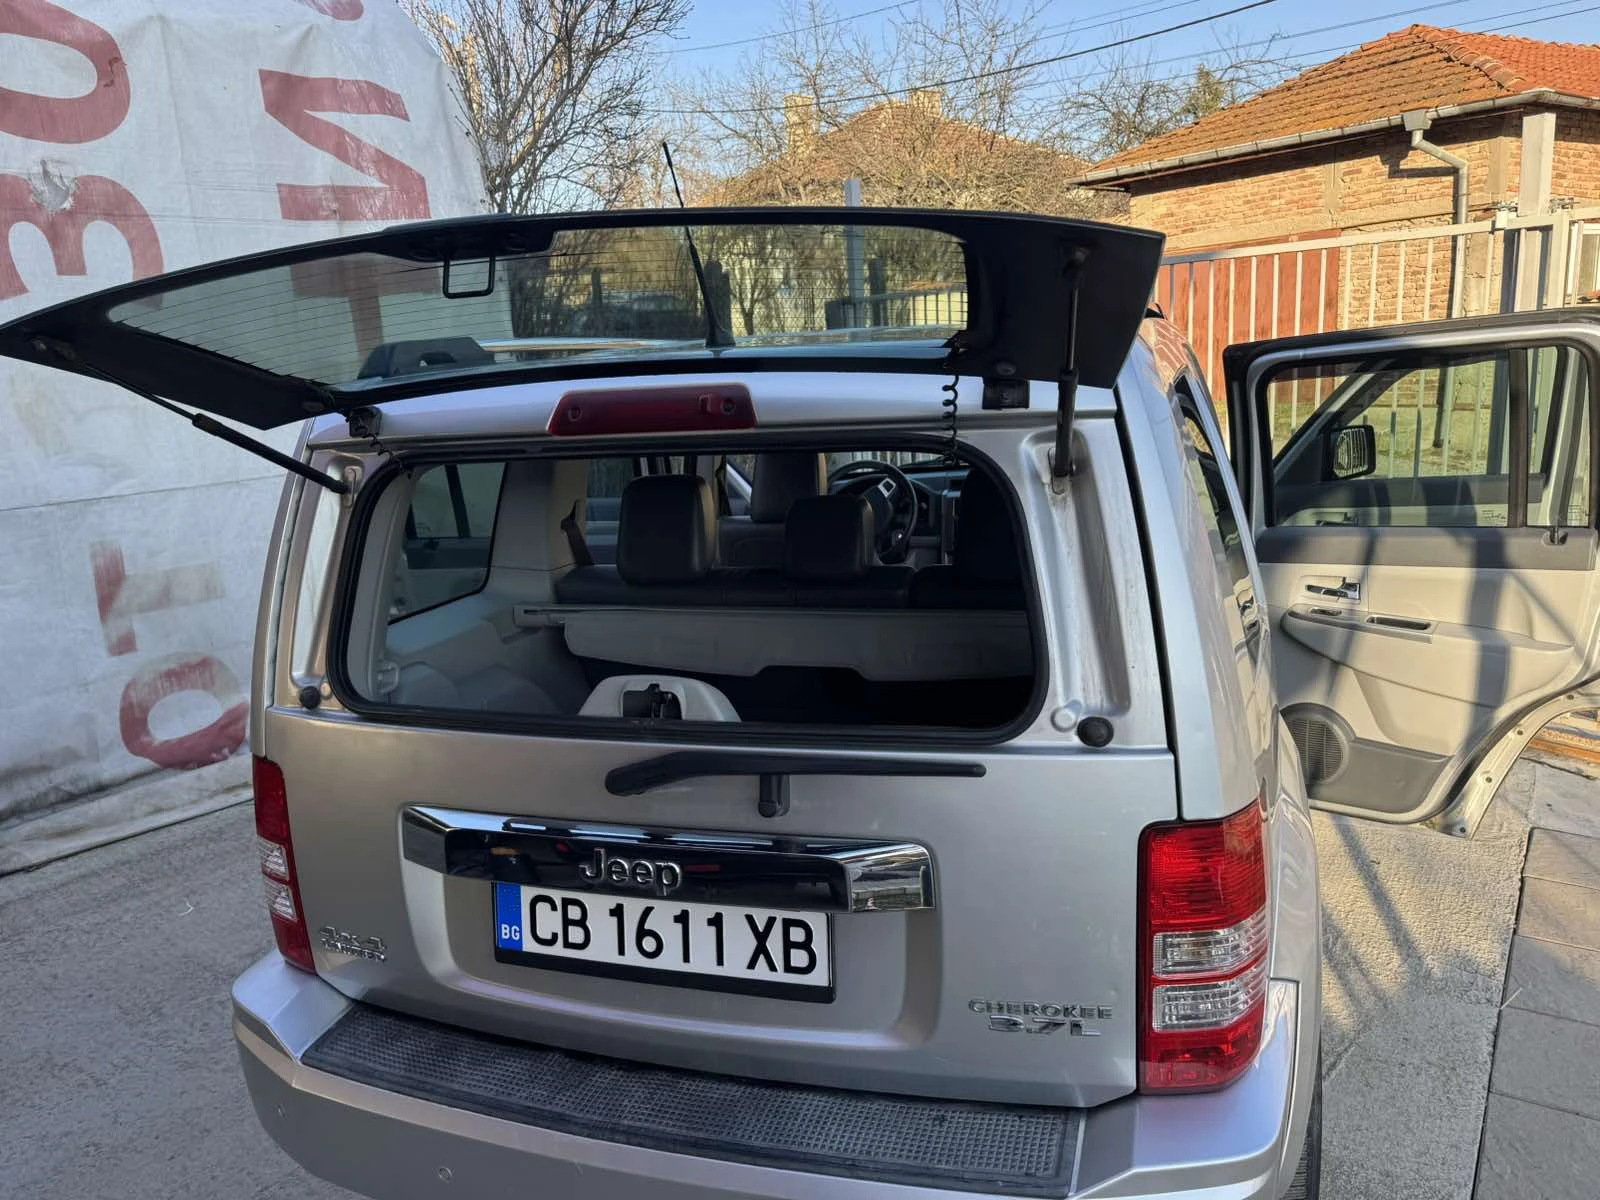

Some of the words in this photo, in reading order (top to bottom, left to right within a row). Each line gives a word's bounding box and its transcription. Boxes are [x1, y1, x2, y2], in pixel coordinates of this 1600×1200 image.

[578, 847, 683, 896] Jeep
[501, 923, 521, 941] BG
[529, 893, 592, 951] CB
[608, 902, 730, 966] 1611
[743, 912, 818, 976] XB
[968, 999, 1113, 1019] CHEROKEE
